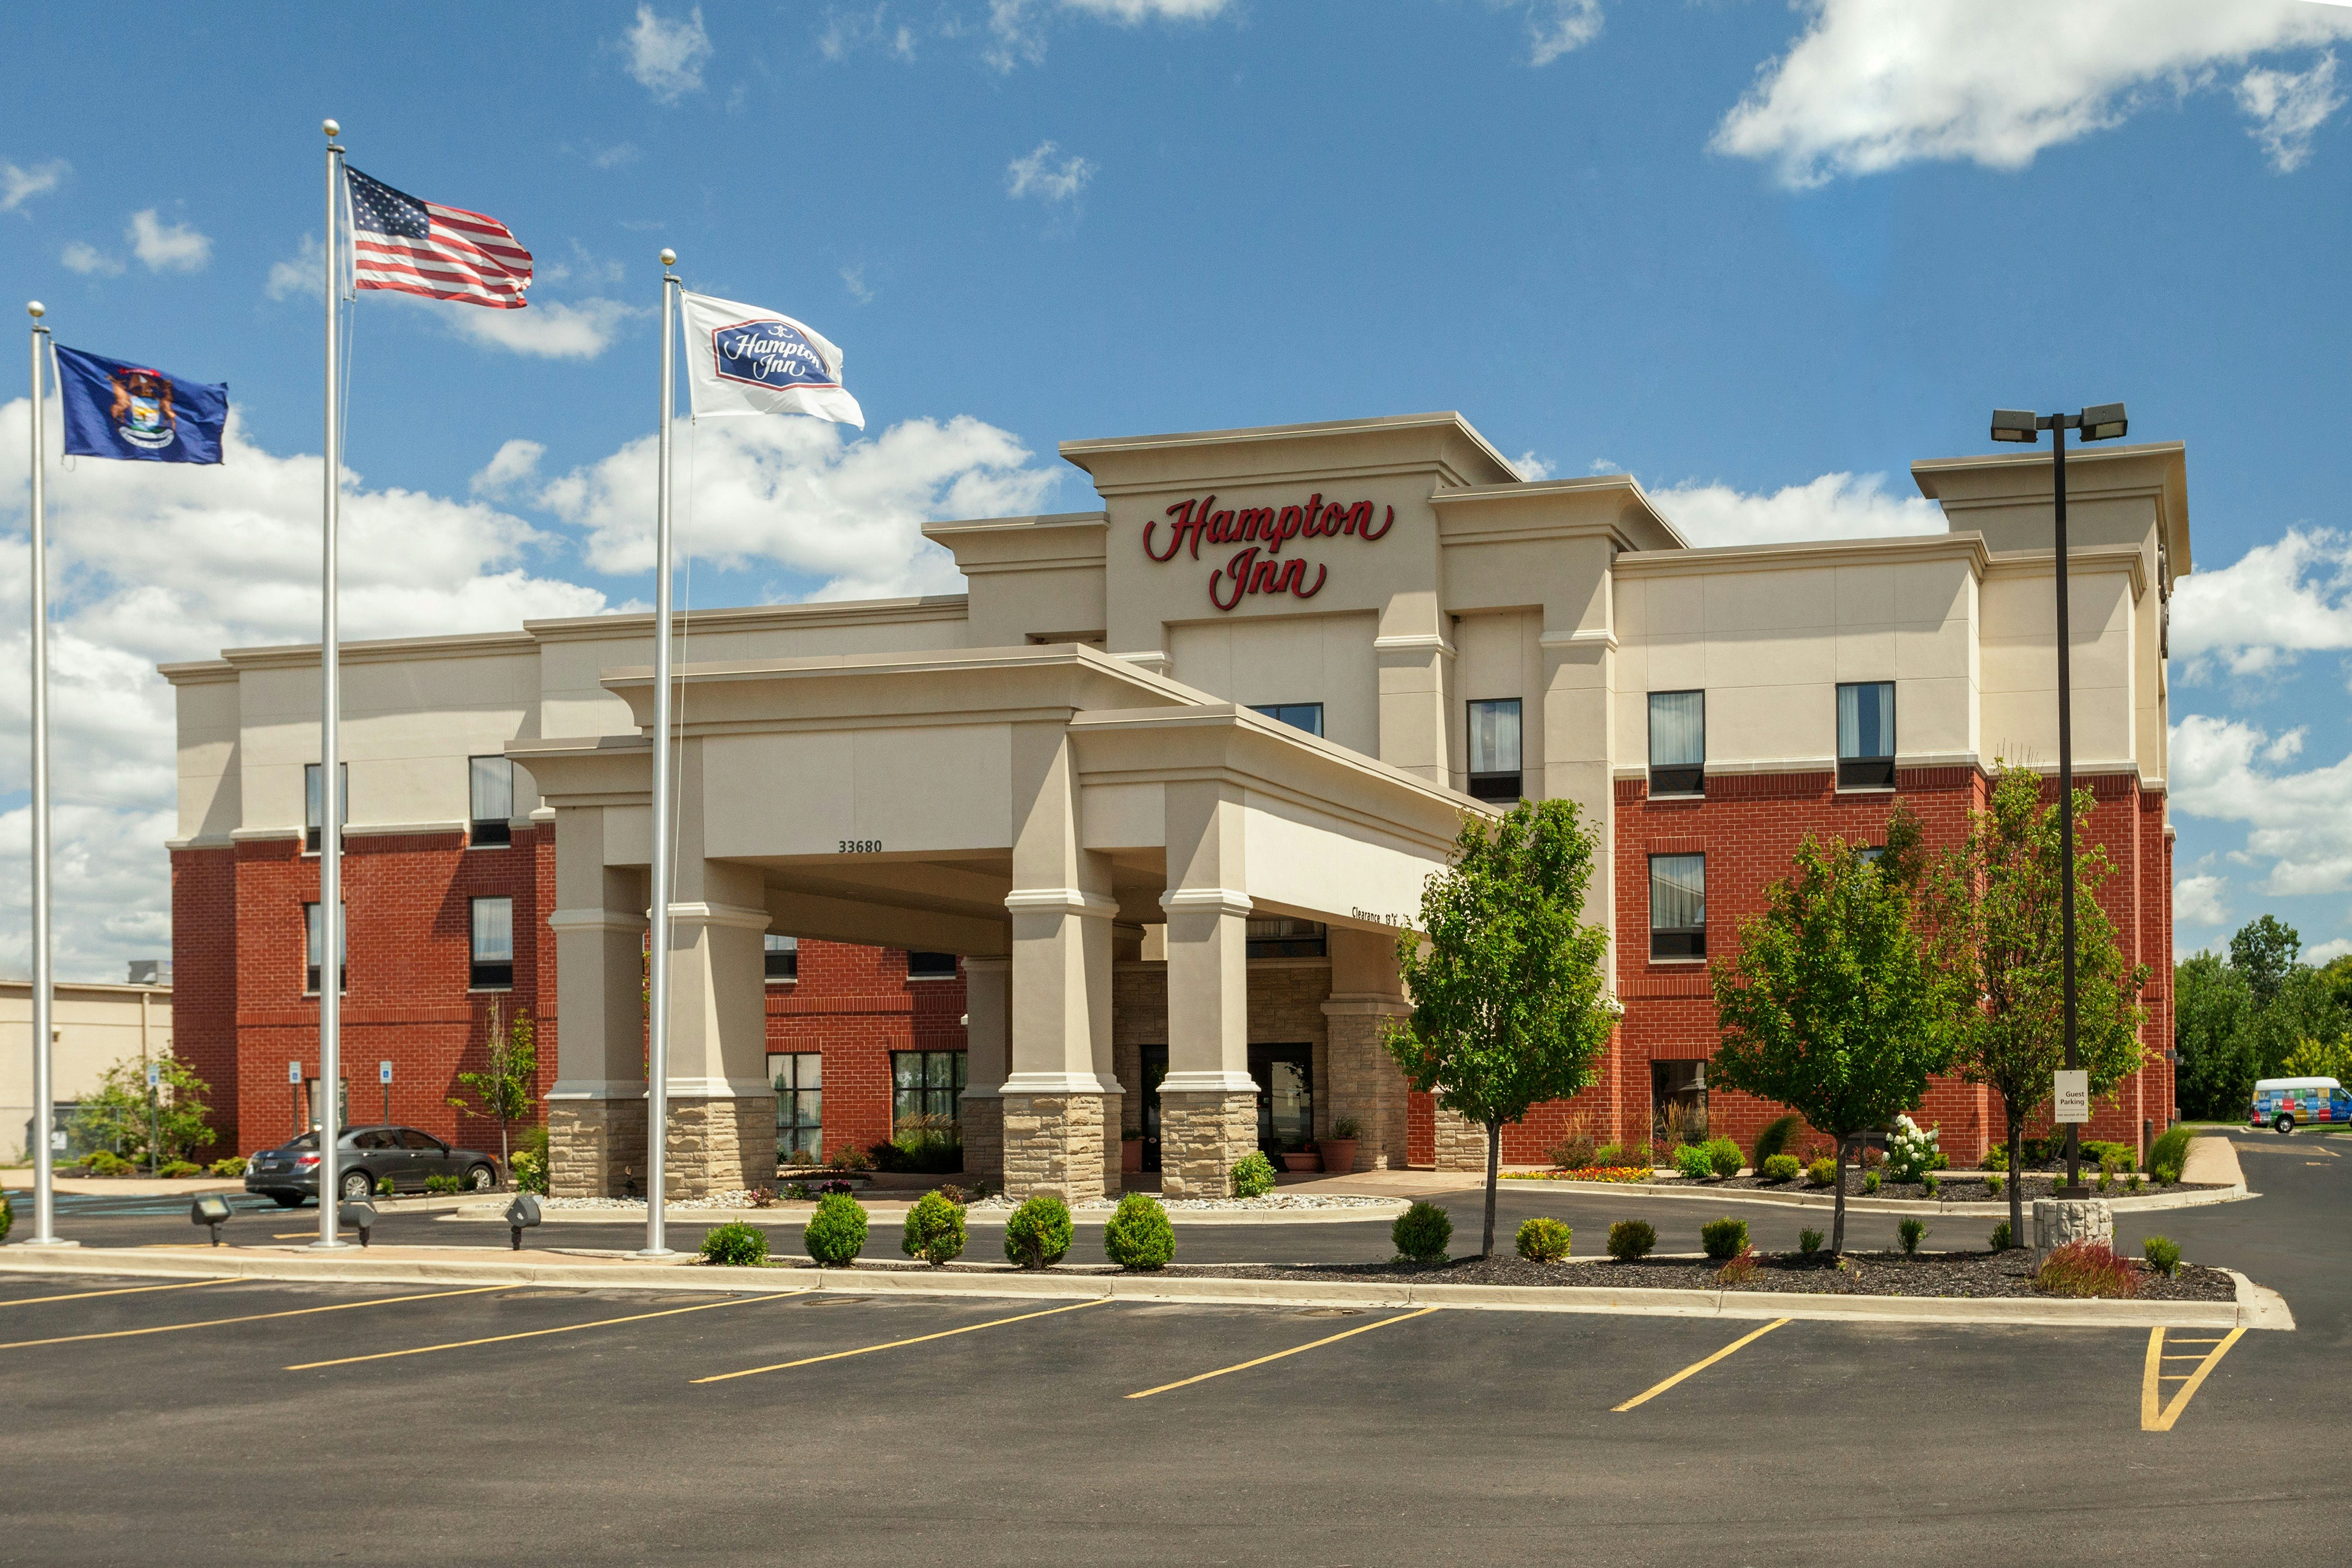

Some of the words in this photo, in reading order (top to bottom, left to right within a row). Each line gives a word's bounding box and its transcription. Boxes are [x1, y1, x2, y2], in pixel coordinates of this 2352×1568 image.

[723, 333, 824, 373] Hampton
[753, 353, 805, 379] Inn
[1143, 493, 1394, 562] Hampton
[1209, 546, 1327, 610] Inn
[839, 840, 882, 853] 33680
[1352, 906, 1380, 923] Clearance
